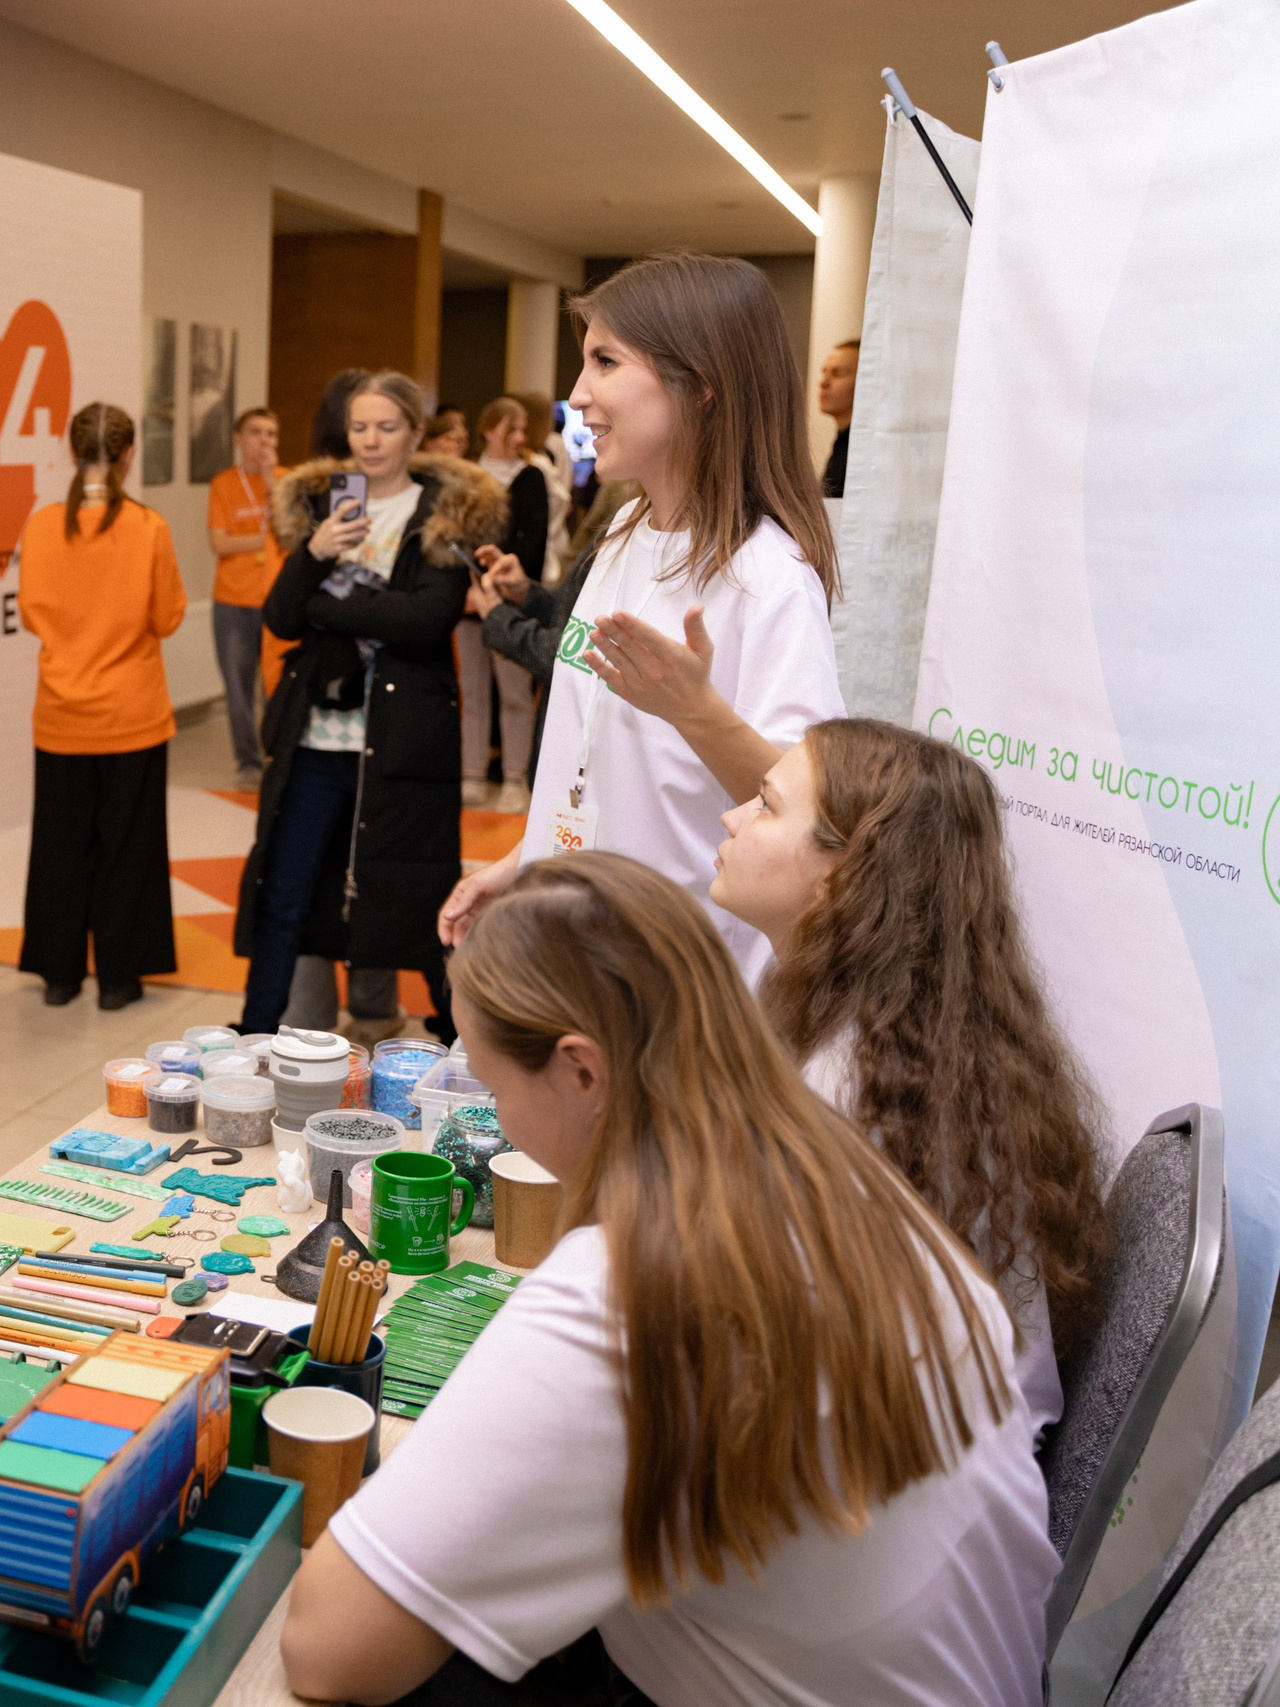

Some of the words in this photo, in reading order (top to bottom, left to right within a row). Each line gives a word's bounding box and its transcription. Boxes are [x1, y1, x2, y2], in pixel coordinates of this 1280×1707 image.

[928, 707, 1037, 770] Следим
[1046, 746, 1079, 783] за
[1091, 758, 1255, 830] чистотой!
[1015, 799, 1048, 824] ПОРТАЛ
[1050, 812, 1072, 831] ДЛЯ
[1072, 817, 1116, 846] ЖИТЕЛЕЙ
[1118, 832, 1183, 867] РЯЗАНСКОЙ
[1185, 853, 1242, 883] ОБЛАСТИ
